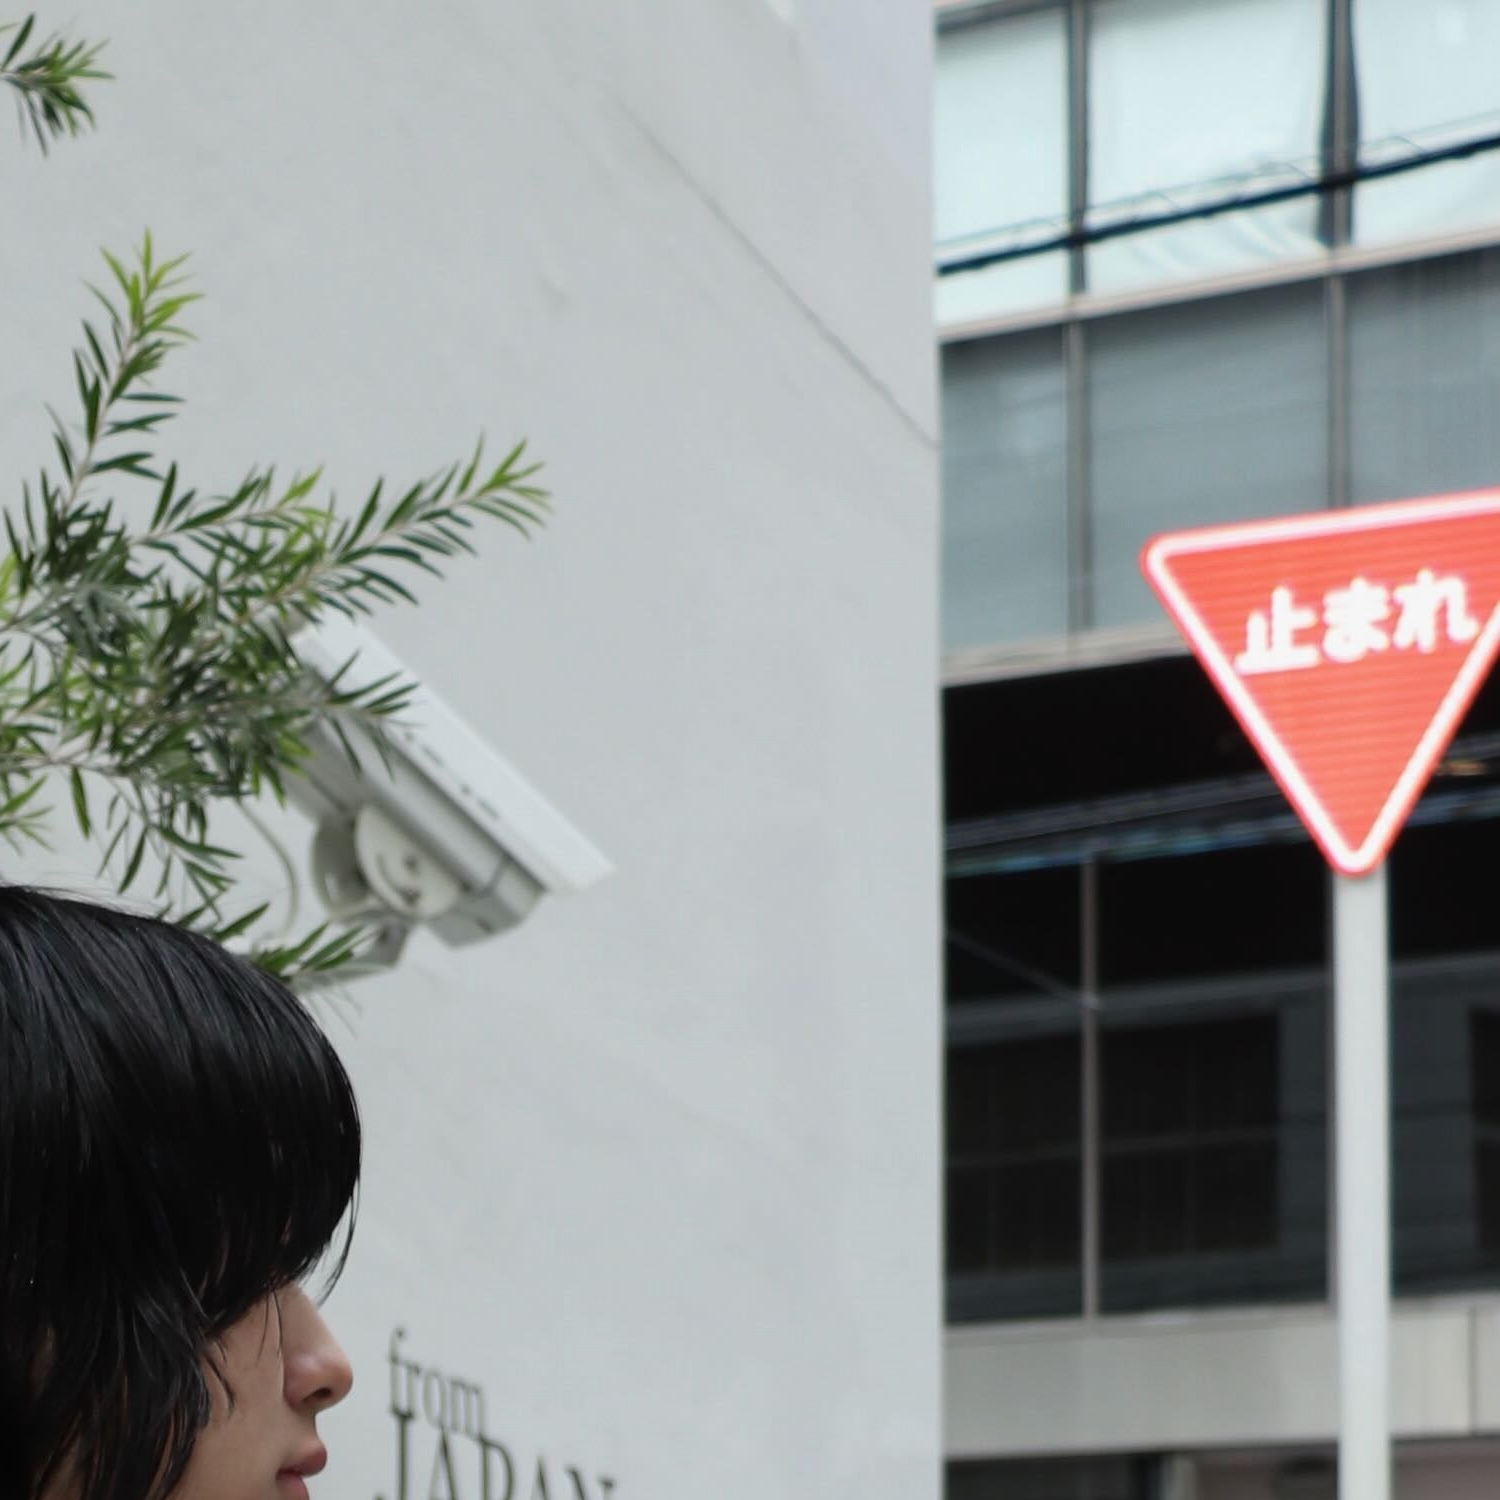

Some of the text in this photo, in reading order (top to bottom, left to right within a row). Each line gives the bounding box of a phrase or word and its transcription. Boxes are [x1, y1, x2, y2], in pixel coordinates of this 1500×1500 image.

[1233, 567, 1480, 676] 止まれ
[387, 1327, 485, 1440] from
